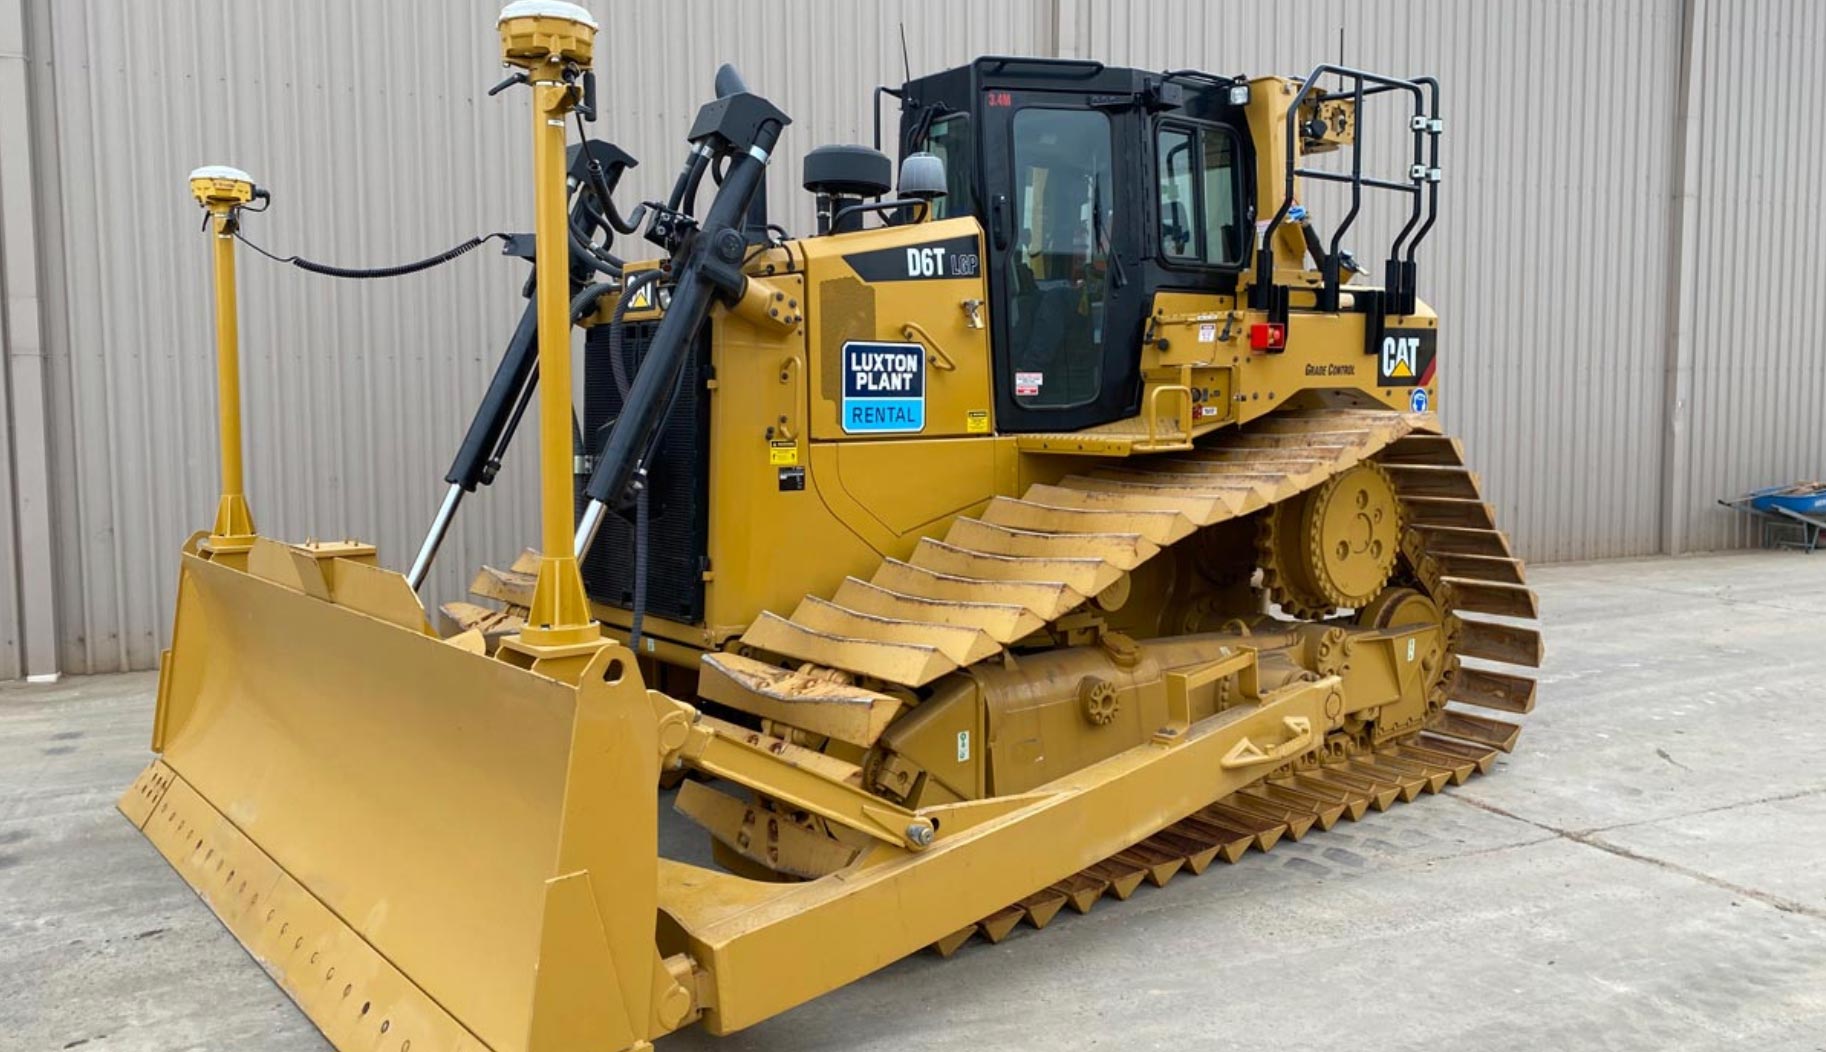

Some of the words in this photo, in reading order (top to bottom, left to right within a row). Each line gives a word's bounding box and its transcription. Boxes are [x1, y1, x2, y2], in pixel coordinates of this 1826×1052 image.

[906, 247, 946, 277] D6T
[950, 254, 978, 276] LGP
[851, 352, 918, 372] LUXTON
[1383, 336, 1420, 377] CAT
[856, 372, 914, 391] PLANT
[852, 406, 915, 424] RENTAL
